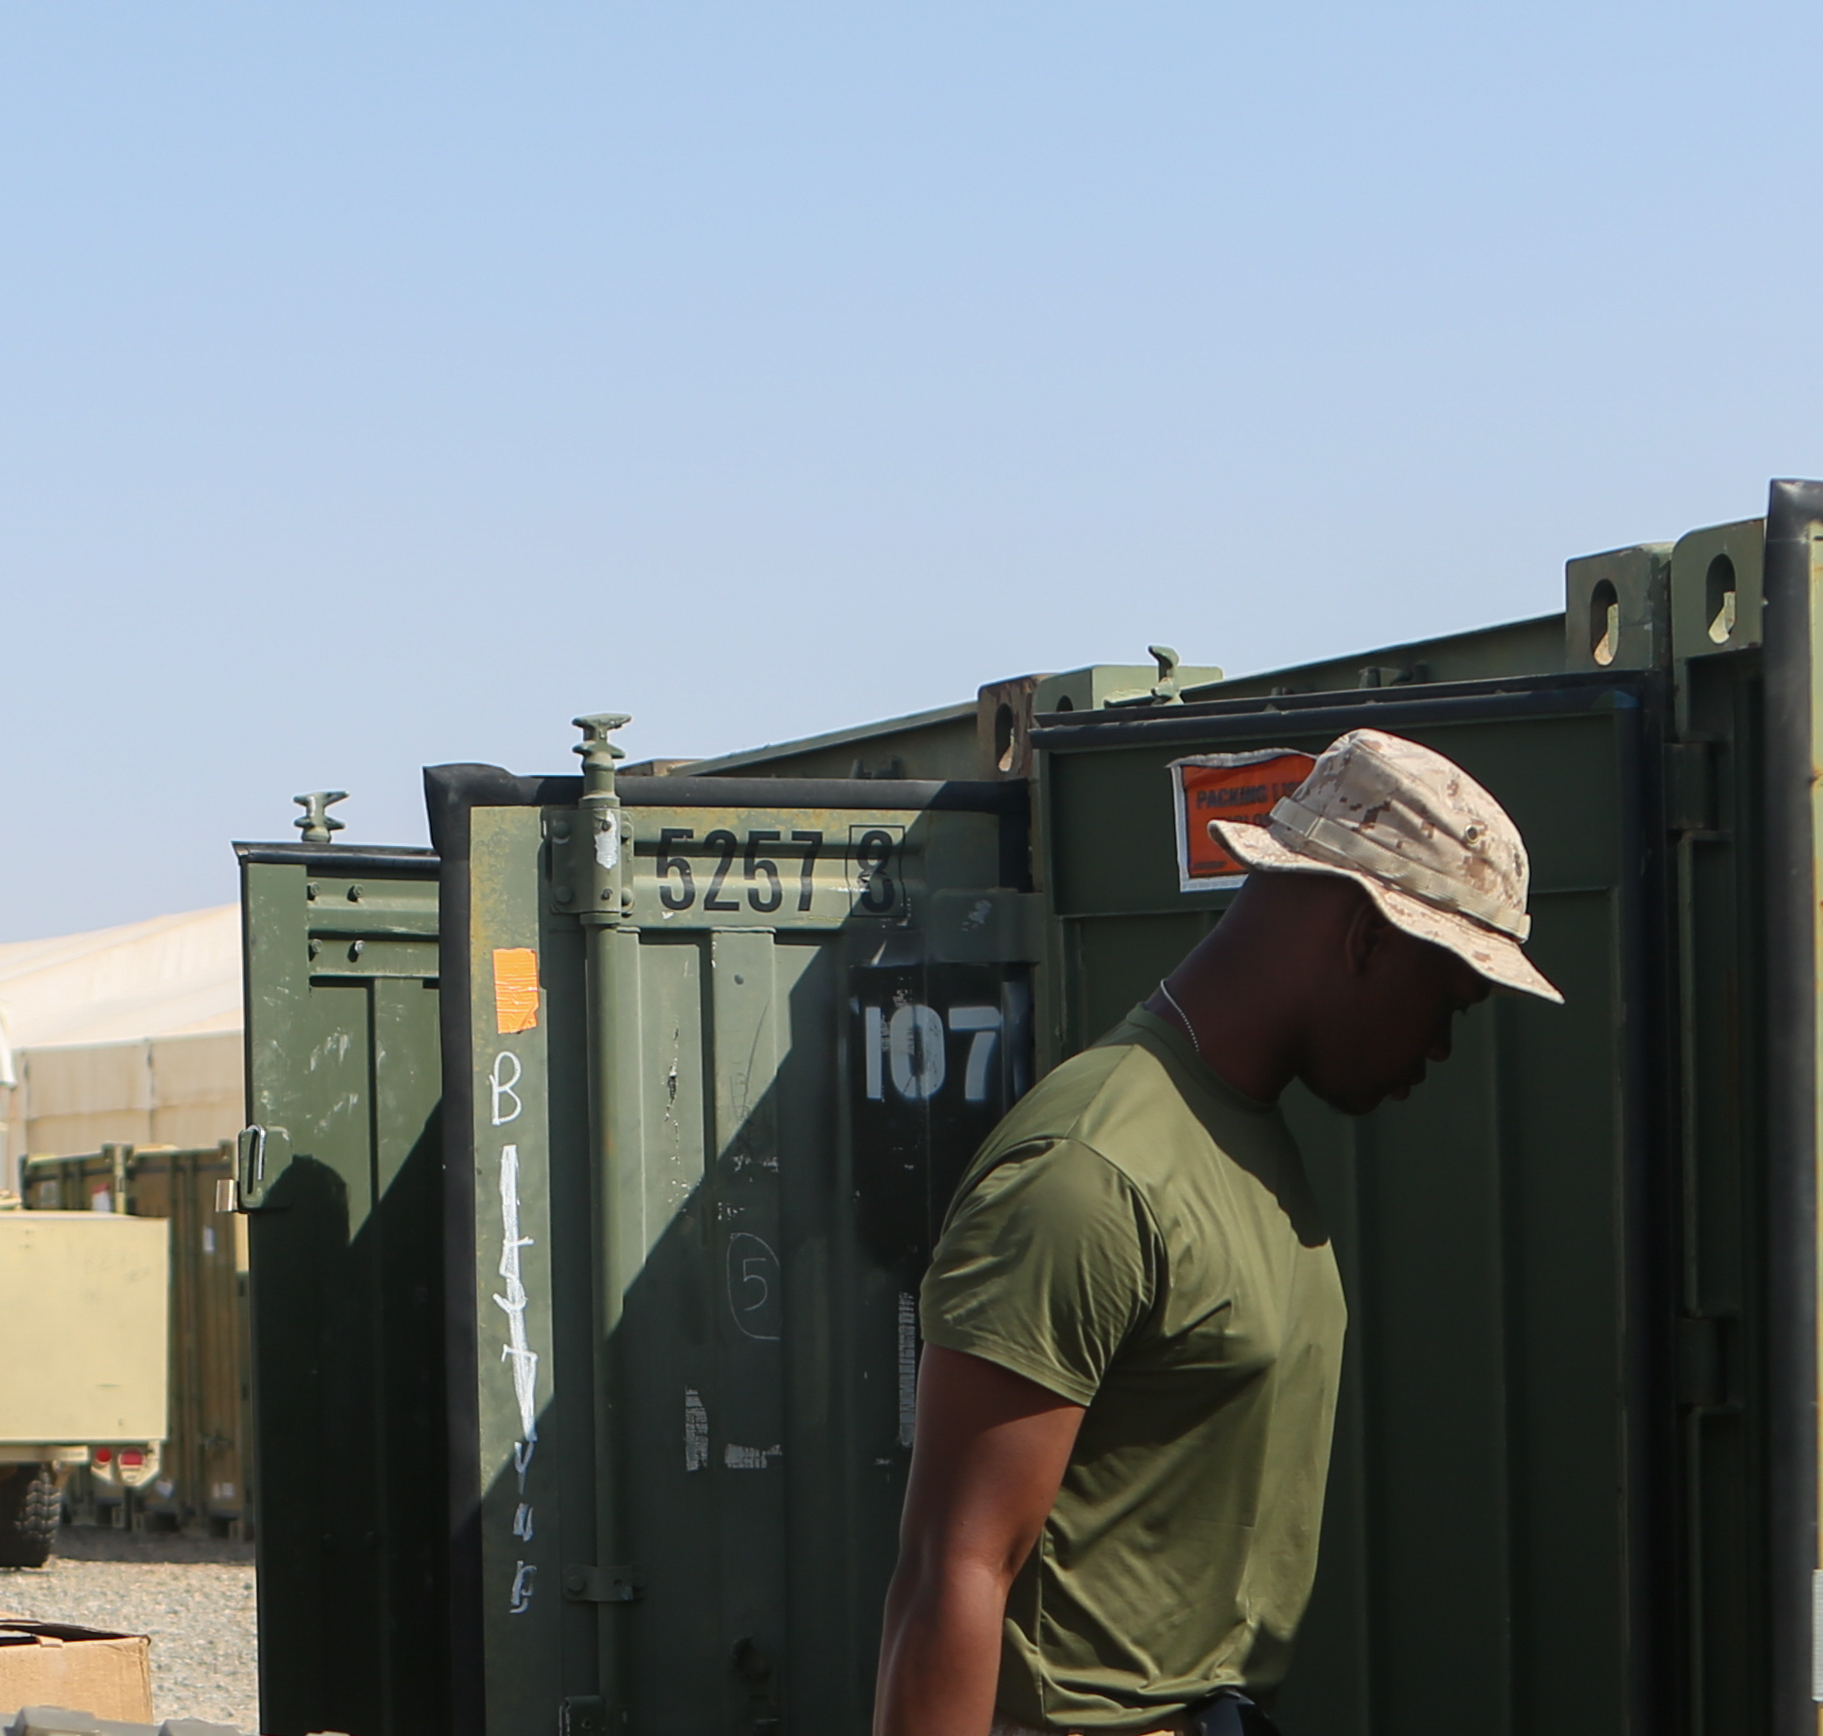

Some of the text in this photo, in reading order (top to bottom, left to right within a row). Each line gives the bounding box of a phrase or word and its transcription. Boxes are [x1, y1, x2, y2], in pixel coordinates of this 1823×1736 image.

[1196, 783, 1269, 809] PACKING
[656, 828, 824, 912] 5257
[865, 1005, 1003, 1100] 107
[743, 1258, 768, 1311] 5
